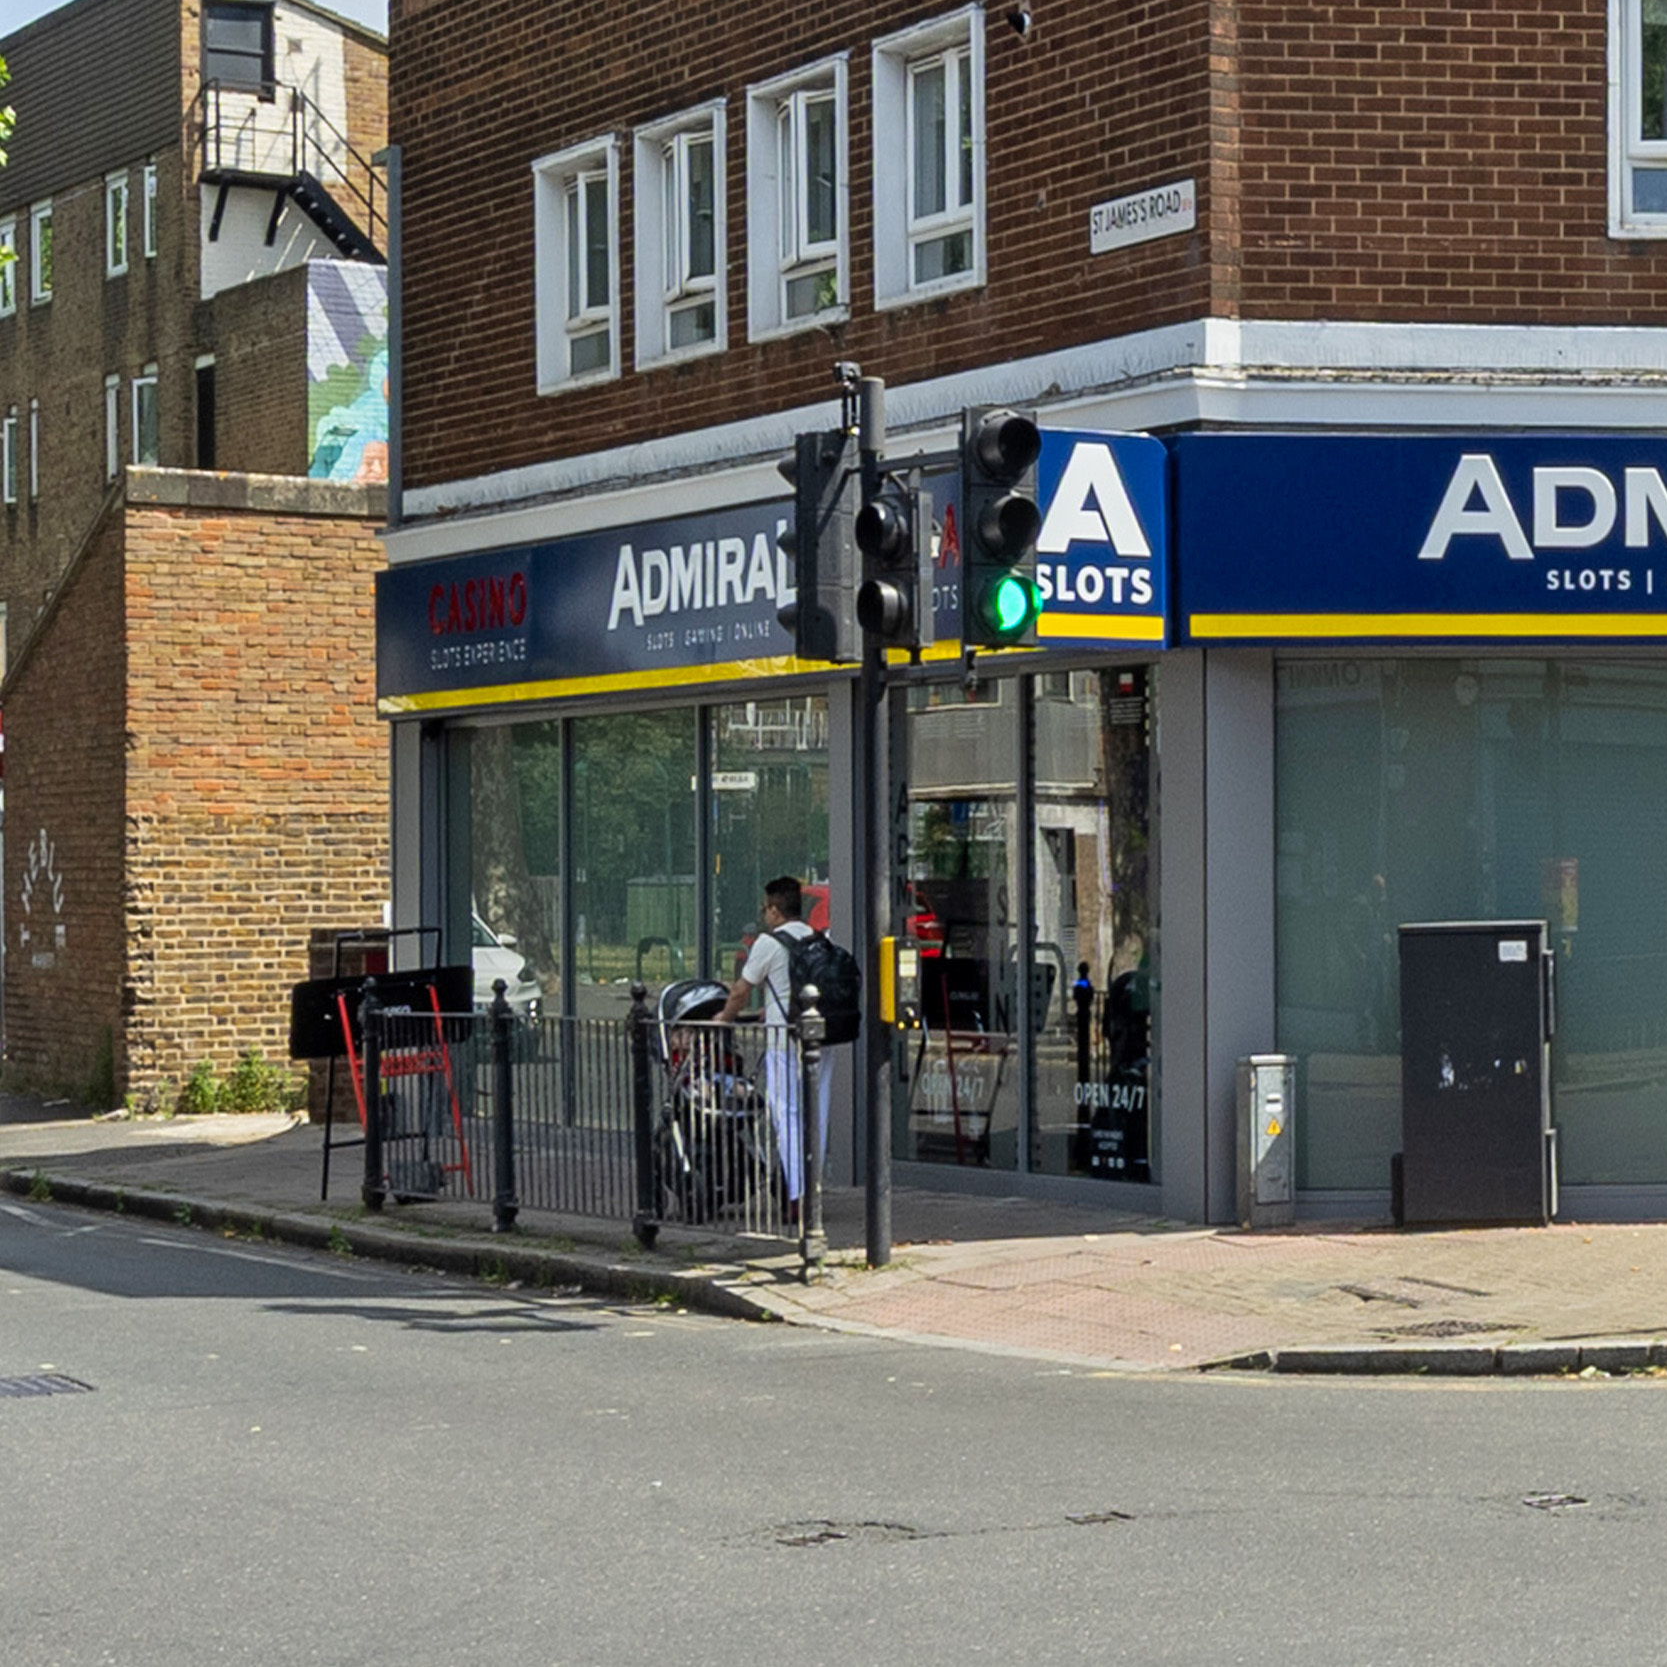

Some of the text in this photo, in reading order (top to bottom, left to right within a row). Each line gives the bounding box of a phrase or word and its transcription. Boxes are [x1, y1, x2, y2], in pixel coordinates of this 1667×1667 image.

[1149, 190, 1181, 218] ROAD
[1036, 442, 1152, 557] A
[607, 519, 798, 631] ADMIRAL
[1036, 563, 1153, 605] SLOTS
[1546, 570, 1632, 591] SLOTS
[428, 571, 527, 635] CASINO
[1074, 1082, 1145, 1112] OPEN 24/7
